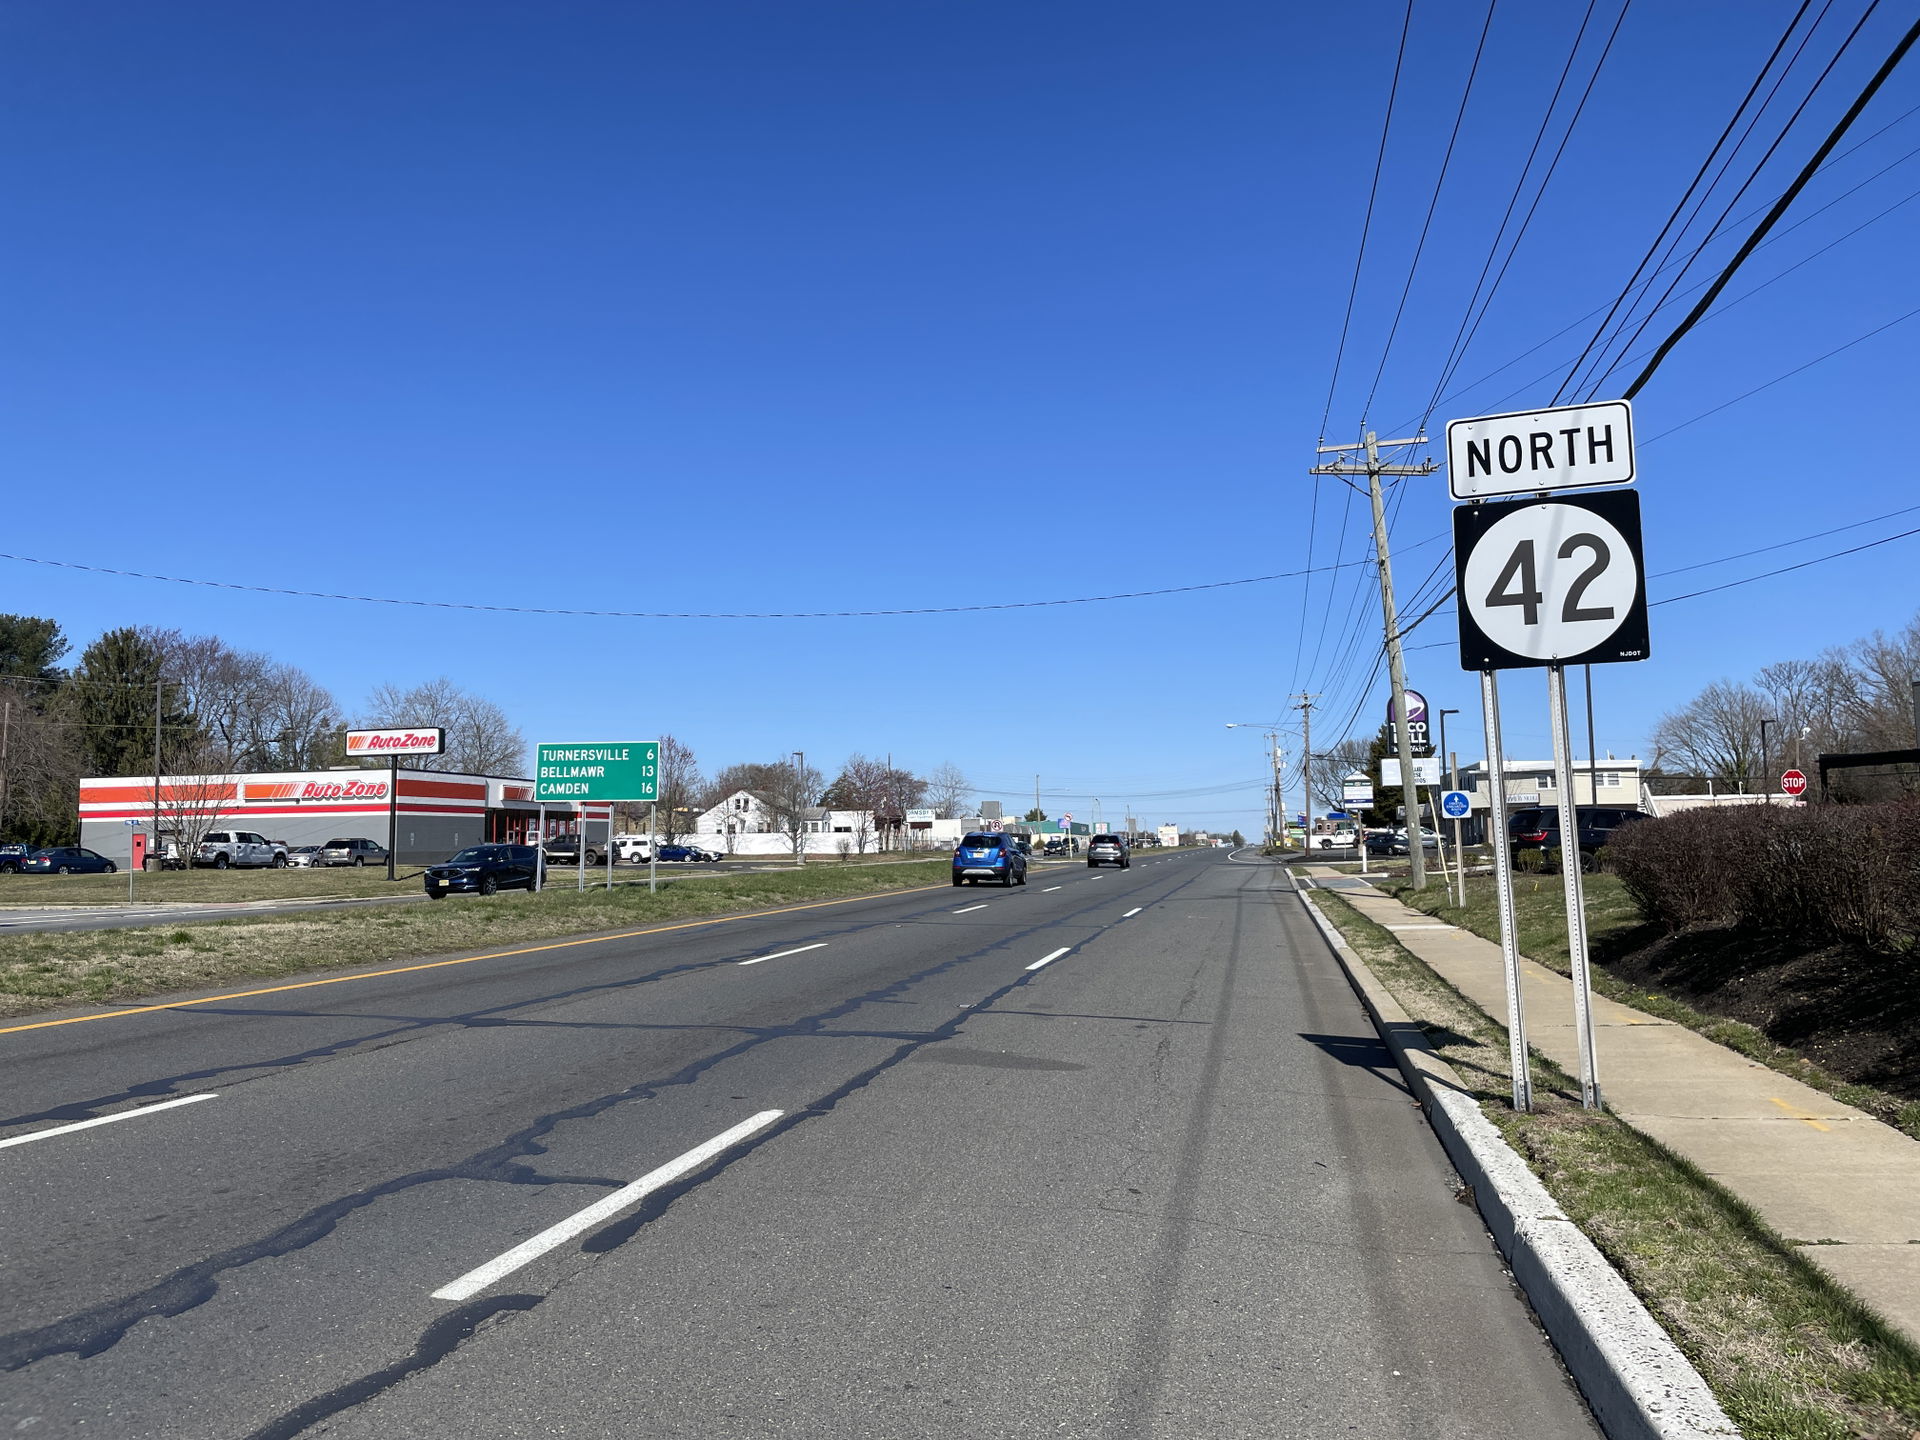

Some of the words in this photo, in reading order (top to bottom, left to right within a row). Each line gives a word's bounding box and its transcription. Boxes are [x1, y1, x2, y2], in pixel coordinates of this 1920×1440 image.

[1466, 424, 1614, 478] NORTH
[1485, 532, 1615, 626] 42
[1619, 650, 1642, 658] NJDOT
[1390, 722, 1427, 733] TCO
[367, 733, 436, 750] AutoZone
[1393, 733, 1427, 744] LL
[541, 747, 630, 761] TURNERSVILLE
[646, 747, 654, 760] 6
[540, 766, 605, 778] BELLMAWR
[641, 765, 654, 777] 13
[540, 782, 589, 794] CAMDEN
[641, 782, 653, 794] 16
[1783, 777, 1805, 788] STOP
[301, 780, 389, 800] AutoZone
